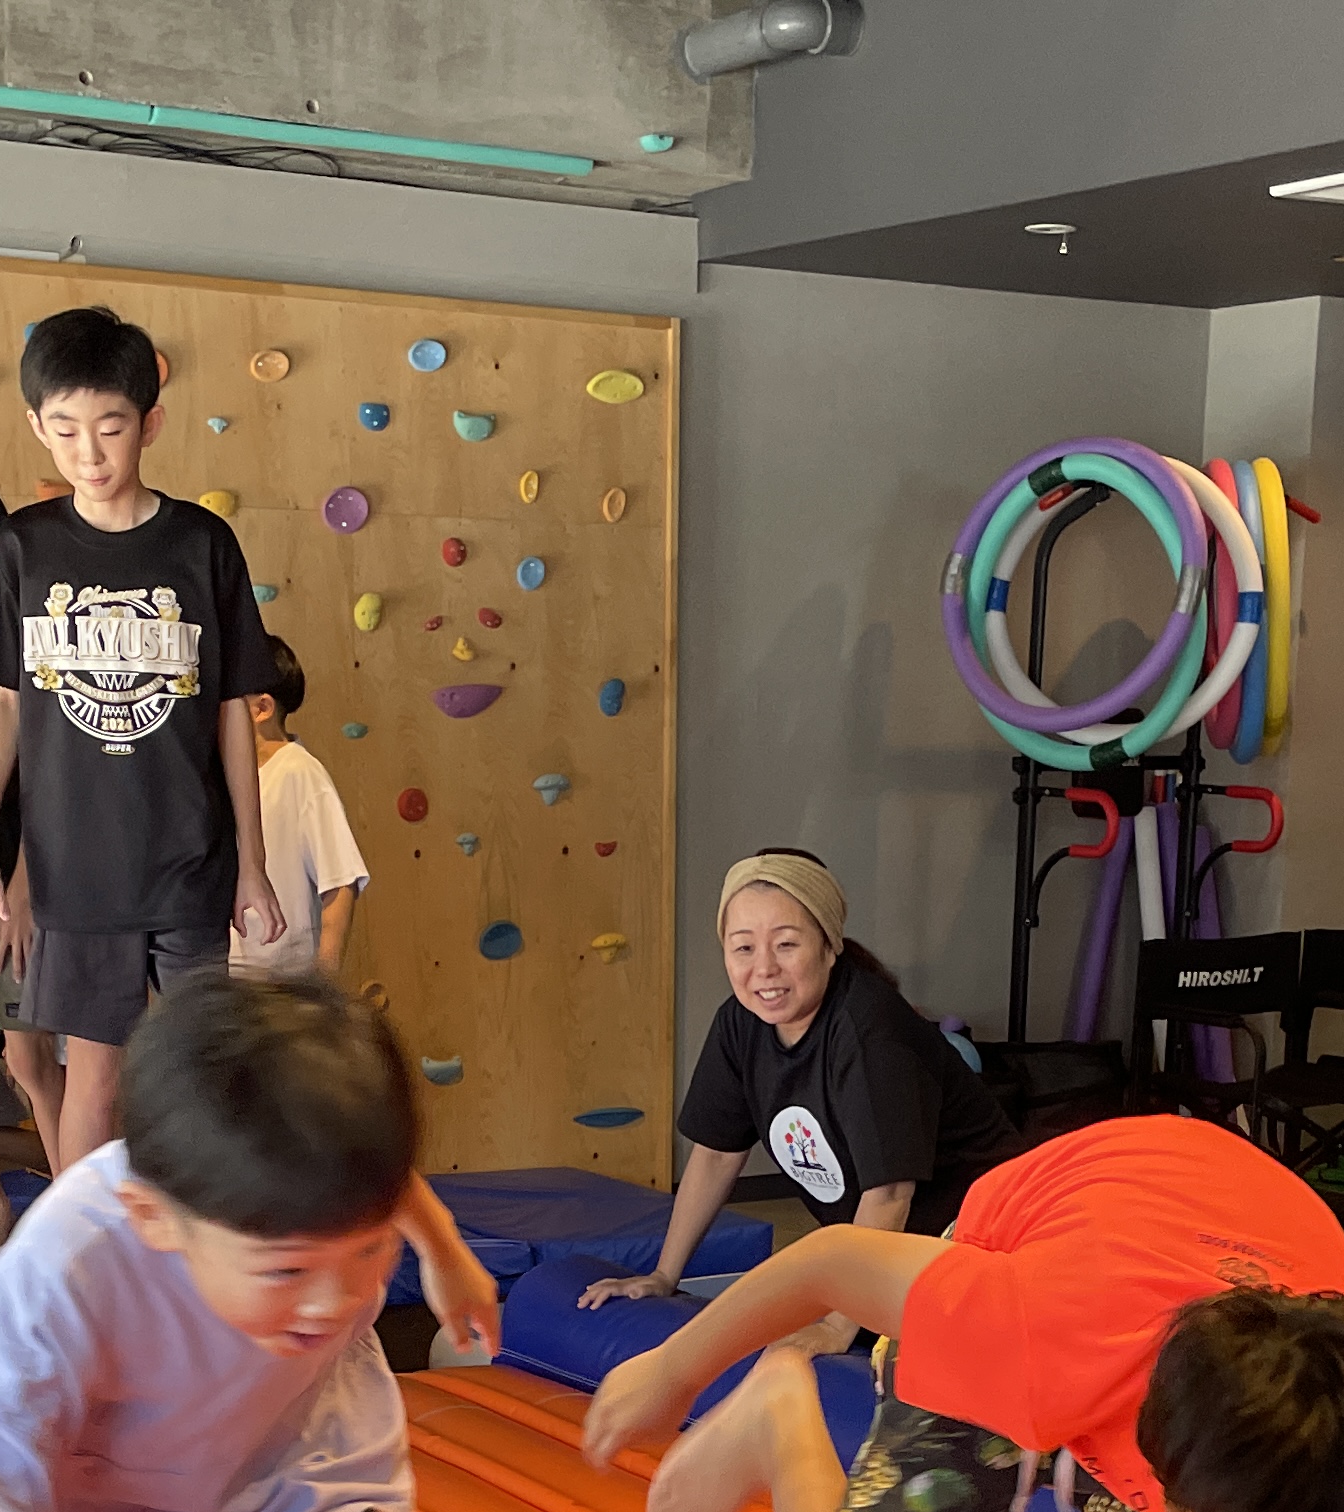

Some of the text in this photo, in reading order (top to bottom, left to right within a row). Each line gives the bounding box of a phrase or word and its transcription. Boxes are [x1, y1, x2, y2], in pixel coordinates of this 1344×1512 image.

[23, 616, 202, 667] ALL KYUSHU
[101, 717, 134, 731] 2024
[1178, 966, 1264, 988] HIROSHI.T
